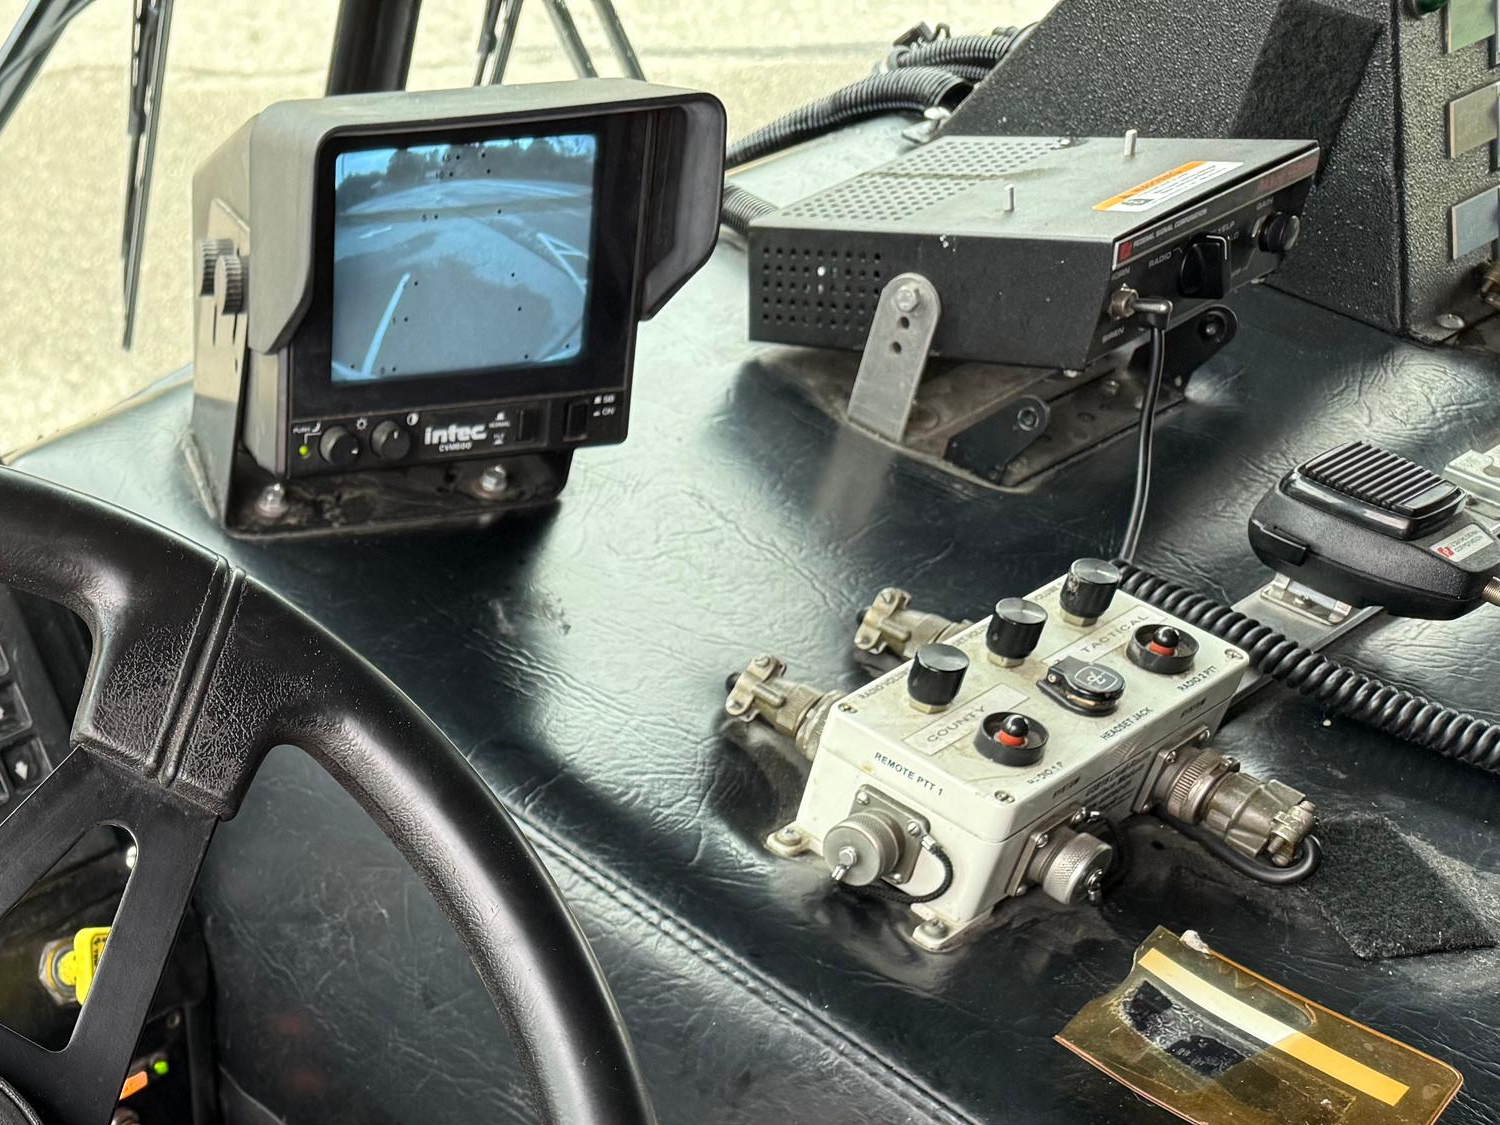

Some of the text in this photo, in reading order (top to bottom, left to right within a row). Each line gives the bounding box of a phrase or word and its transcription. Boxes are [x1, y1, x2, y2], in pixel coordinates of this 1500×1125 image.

[1149, 250, 1172, 268] RADIO
[424, 423, 487, 445] intec
[1081, 614, 1148, 653] TACTICAL
[1177, 676, 1200, 692] RADIO
[927, 705, 985, 743] COUNTY
[1100, 707, 1154, 741] HEADSET JACK
[874, 752, 915, 780] REMOTE
[917, 776, 936, 790] PTT
